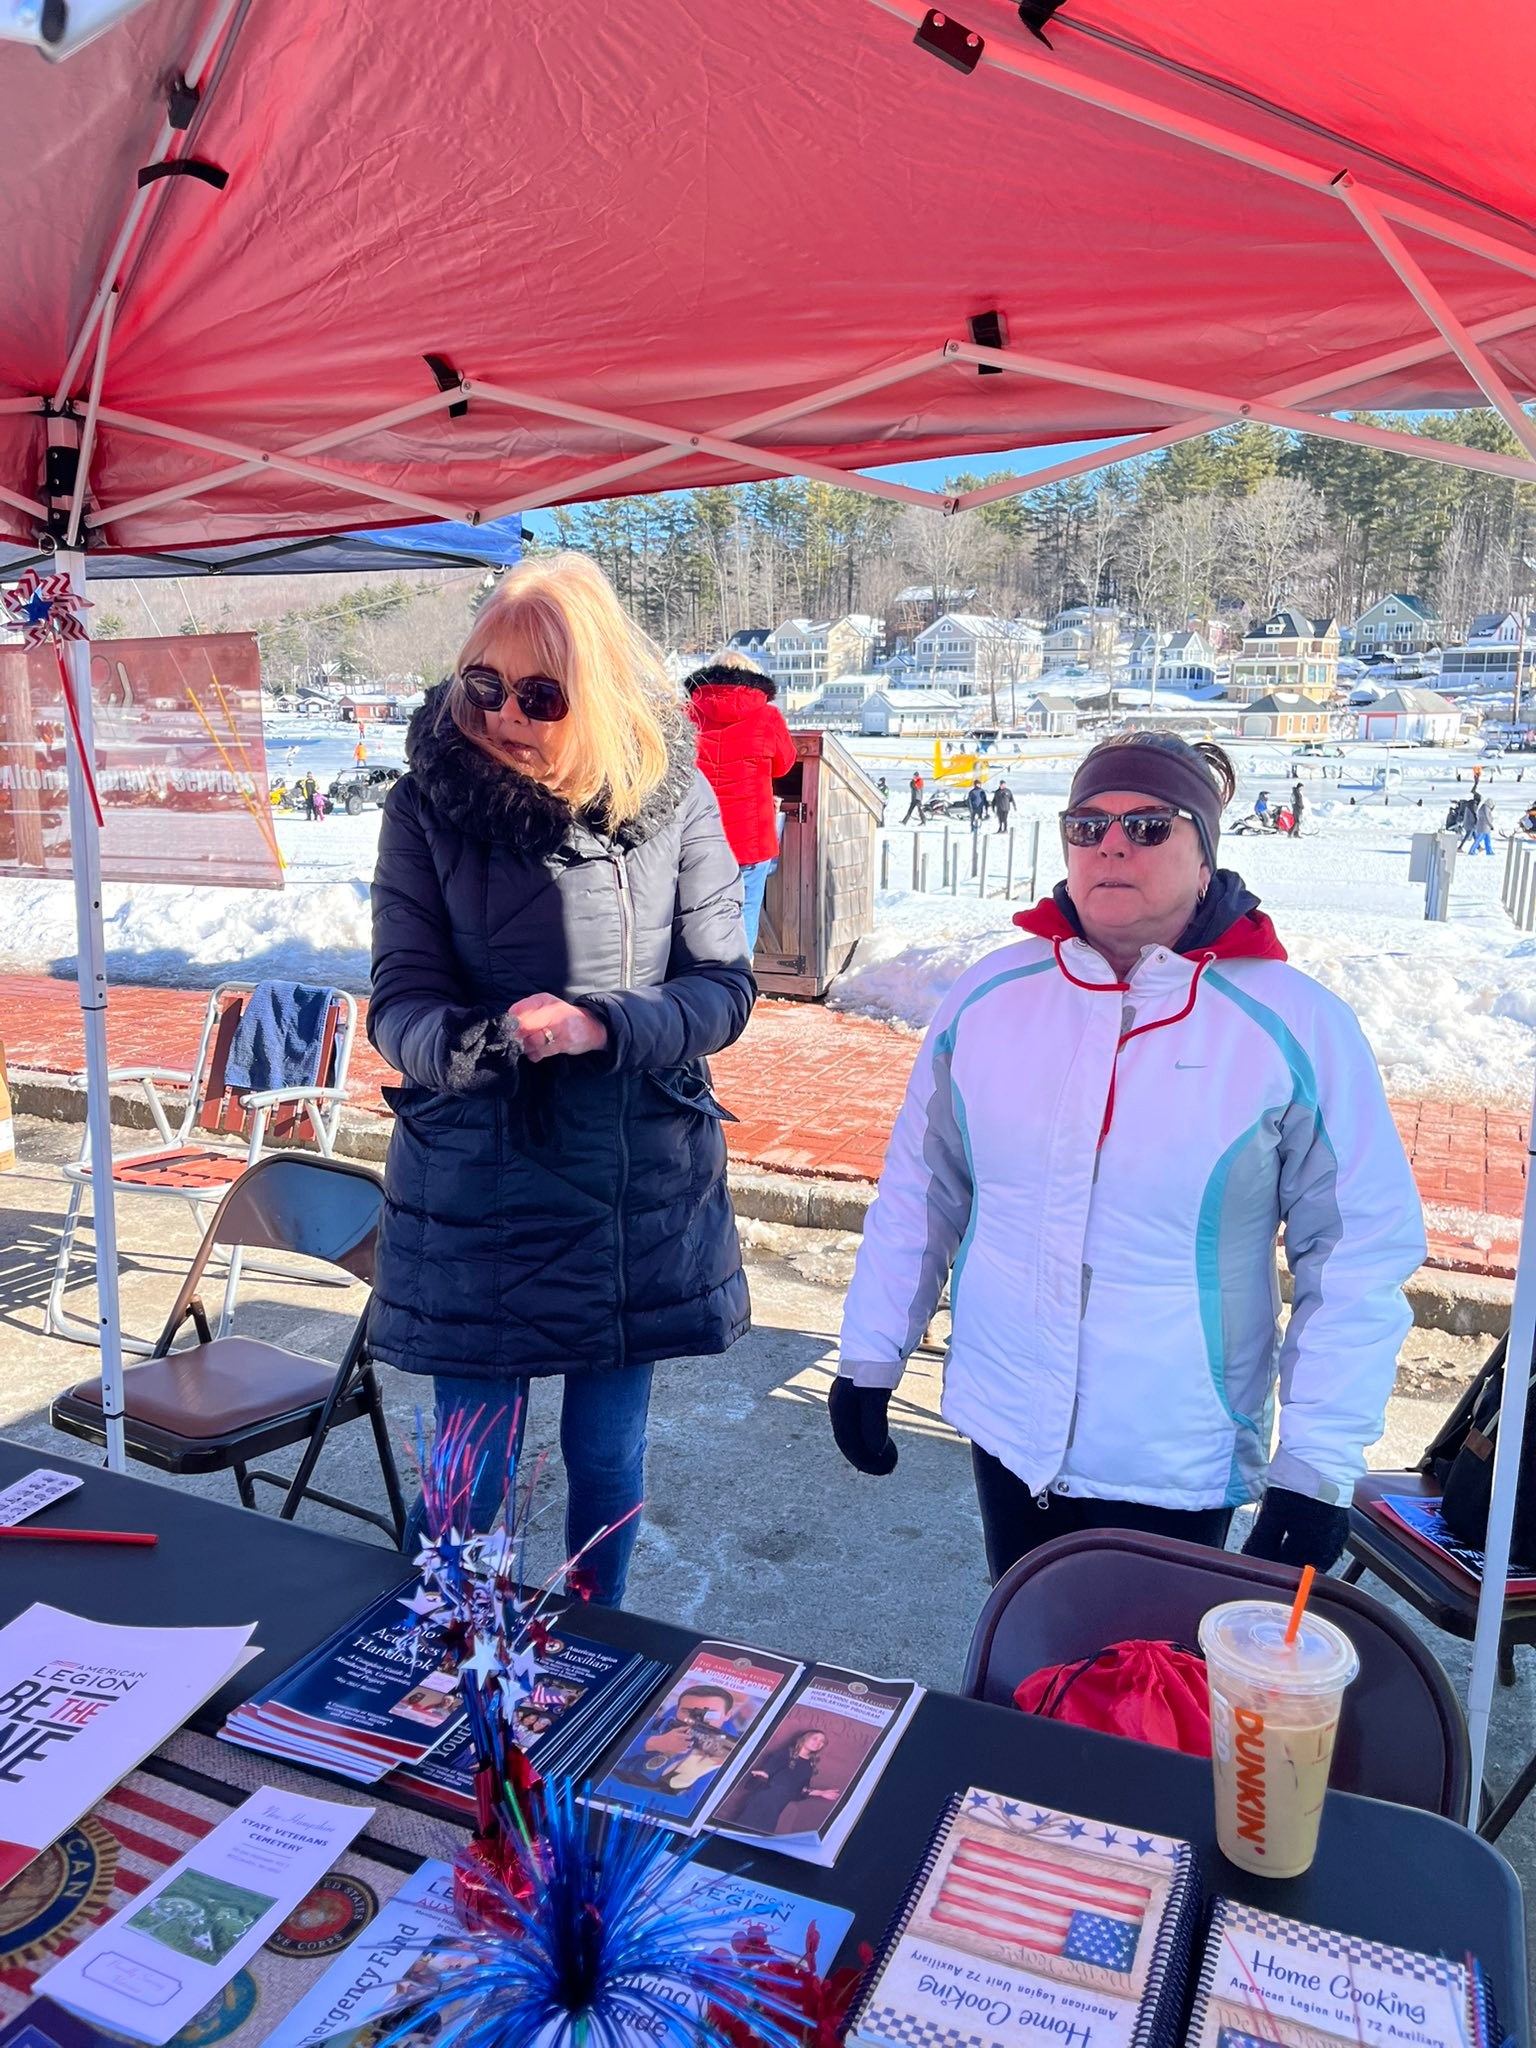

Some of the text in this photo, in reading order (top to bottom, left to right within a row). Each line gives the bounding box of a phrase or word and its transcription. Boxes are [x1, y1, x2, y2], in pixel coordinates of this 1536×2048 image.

[1, 763, 54, 790] Alton
[172, 766, 256, 793] Services
[352, 1636, 435, 1671] Handbook
[559, 1650, 613, 1673] Auxiliary
[32, 1665, 140, 1692] LEGION
[77, 1665, 148, 1679] AMERICAN
[0, 1680, 110, 1725] BE THE
[850, 1705, 881, 1719] PROGRAM
[0, 1722, 75, 1784] NE
[241, 1817, 329, 1848] STATE VETERANS
[248, 1832, 304, 1853] CEMETERY
[344, 1886, 365, 1921] STATES
[297, 1933, 343, 1950] CORPS
[298, 1923, 419, 2048] mergency Fund
[910, 1949, 1118, 2021] American Legion Unit 72 Auxiliary
[1251, 1950, 1426, 2025] Home Cooking
[917, 1974, 1094, 2048] Home Cooking
[1230, 1976, 1285, 2003] American
[1290, 1995, 1329, 2017] Legion
[1335, 2008, 1360, 2026] Unit
[1367, 2018, 1382, 2032] 72
[1388, 2024, 1445, 2048] Auxiliary
